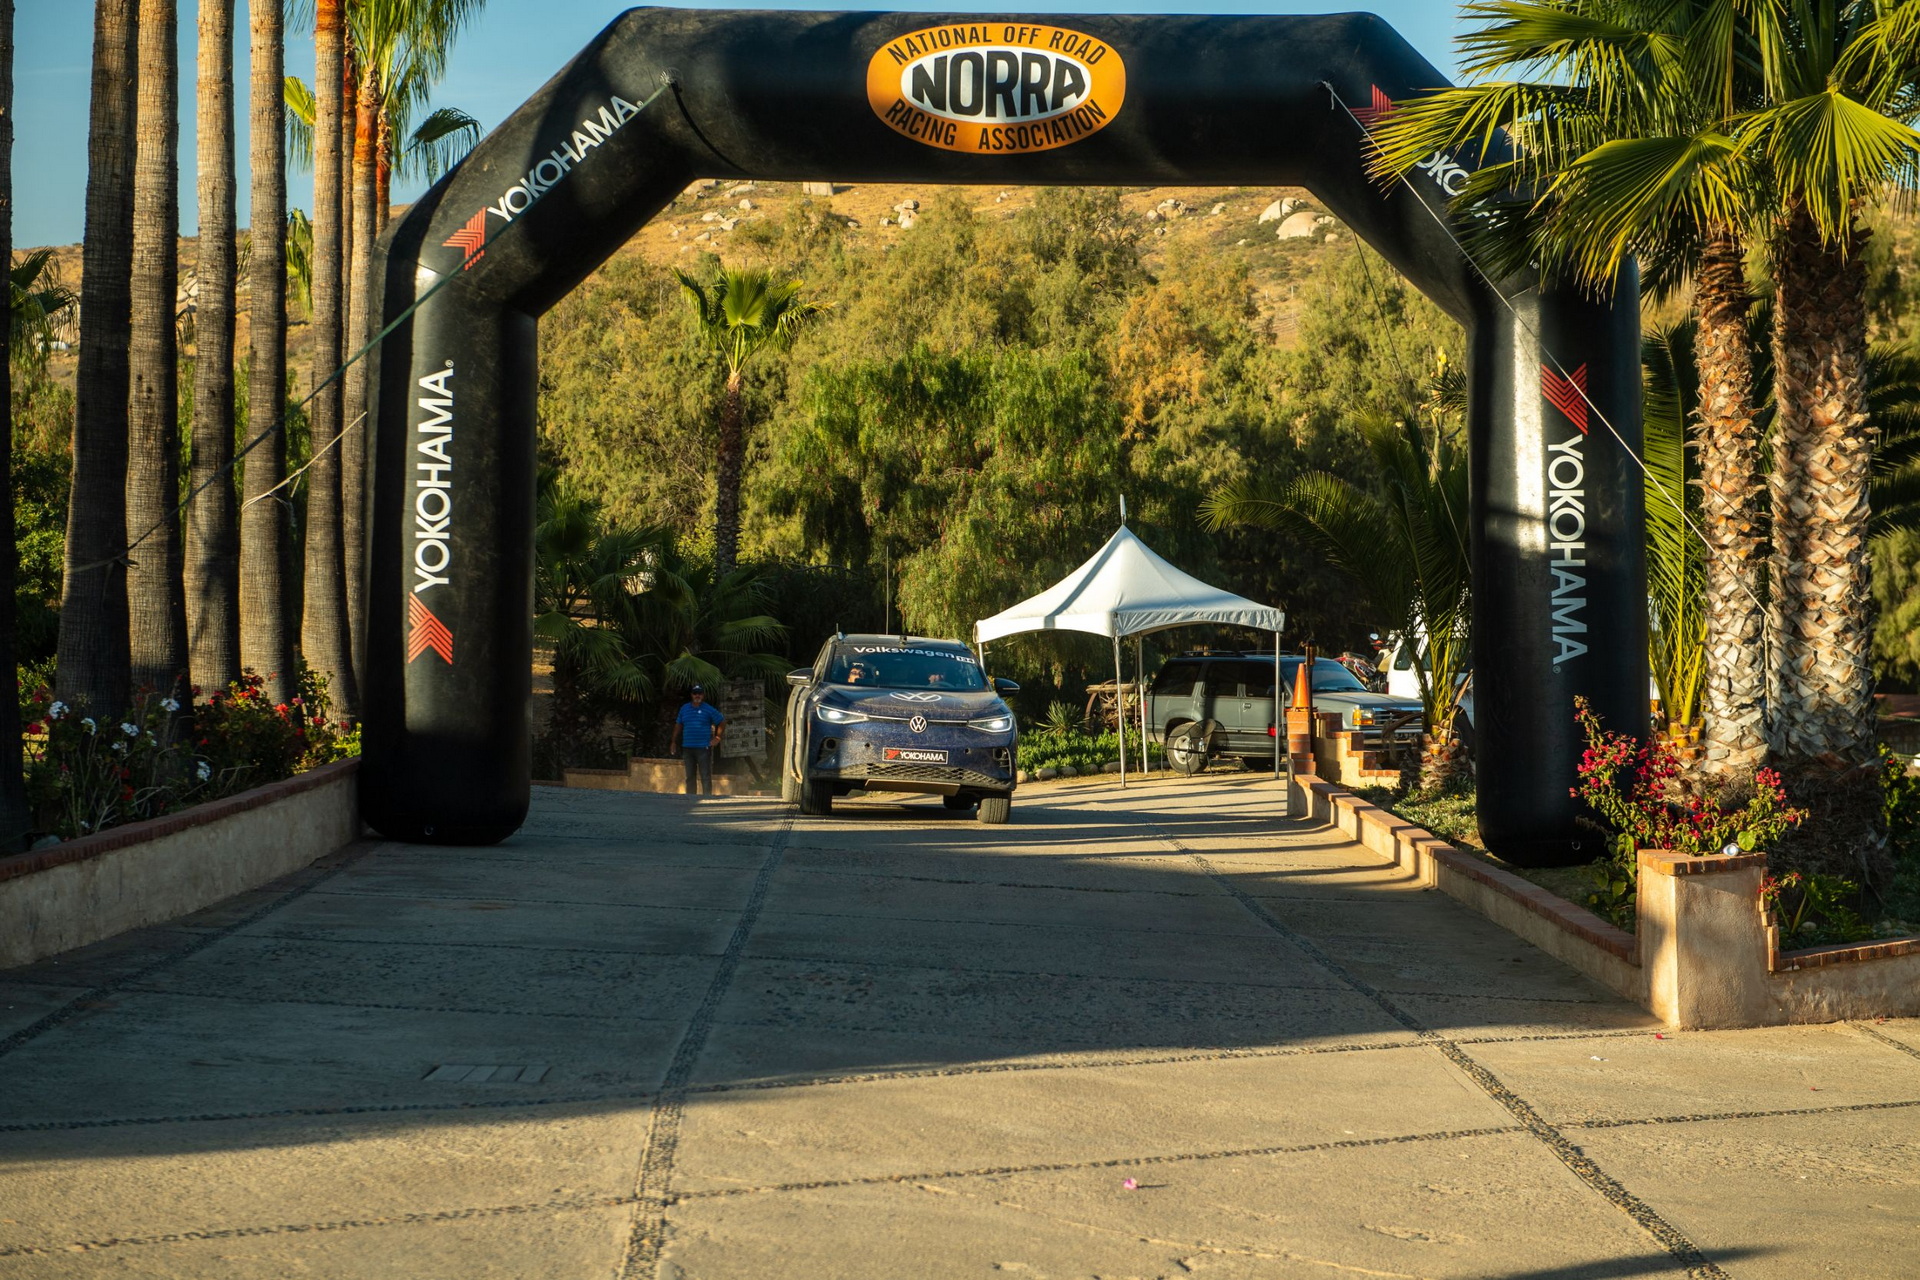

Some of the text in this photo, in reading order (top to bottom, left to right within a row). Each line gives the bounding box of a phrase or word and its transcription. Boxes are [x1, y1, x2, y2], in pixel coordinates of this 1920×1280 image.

[887, 25, 1106, 65] NATIONAL OFF ROAD
[912, 50, 1086, 117] NORRA
[885, 98, 1107, 150] RACING ASSOCIATION
[487, 95, 639, 222] YOKOHAMA
[414, 368, 454, 593] YOKOHAMA
[1548, 434, 1588, 665] YOKOHAMA
[853, 646, 955, 659] Volkswagen
[900, 751, 945, 761] YOKOHAMA
